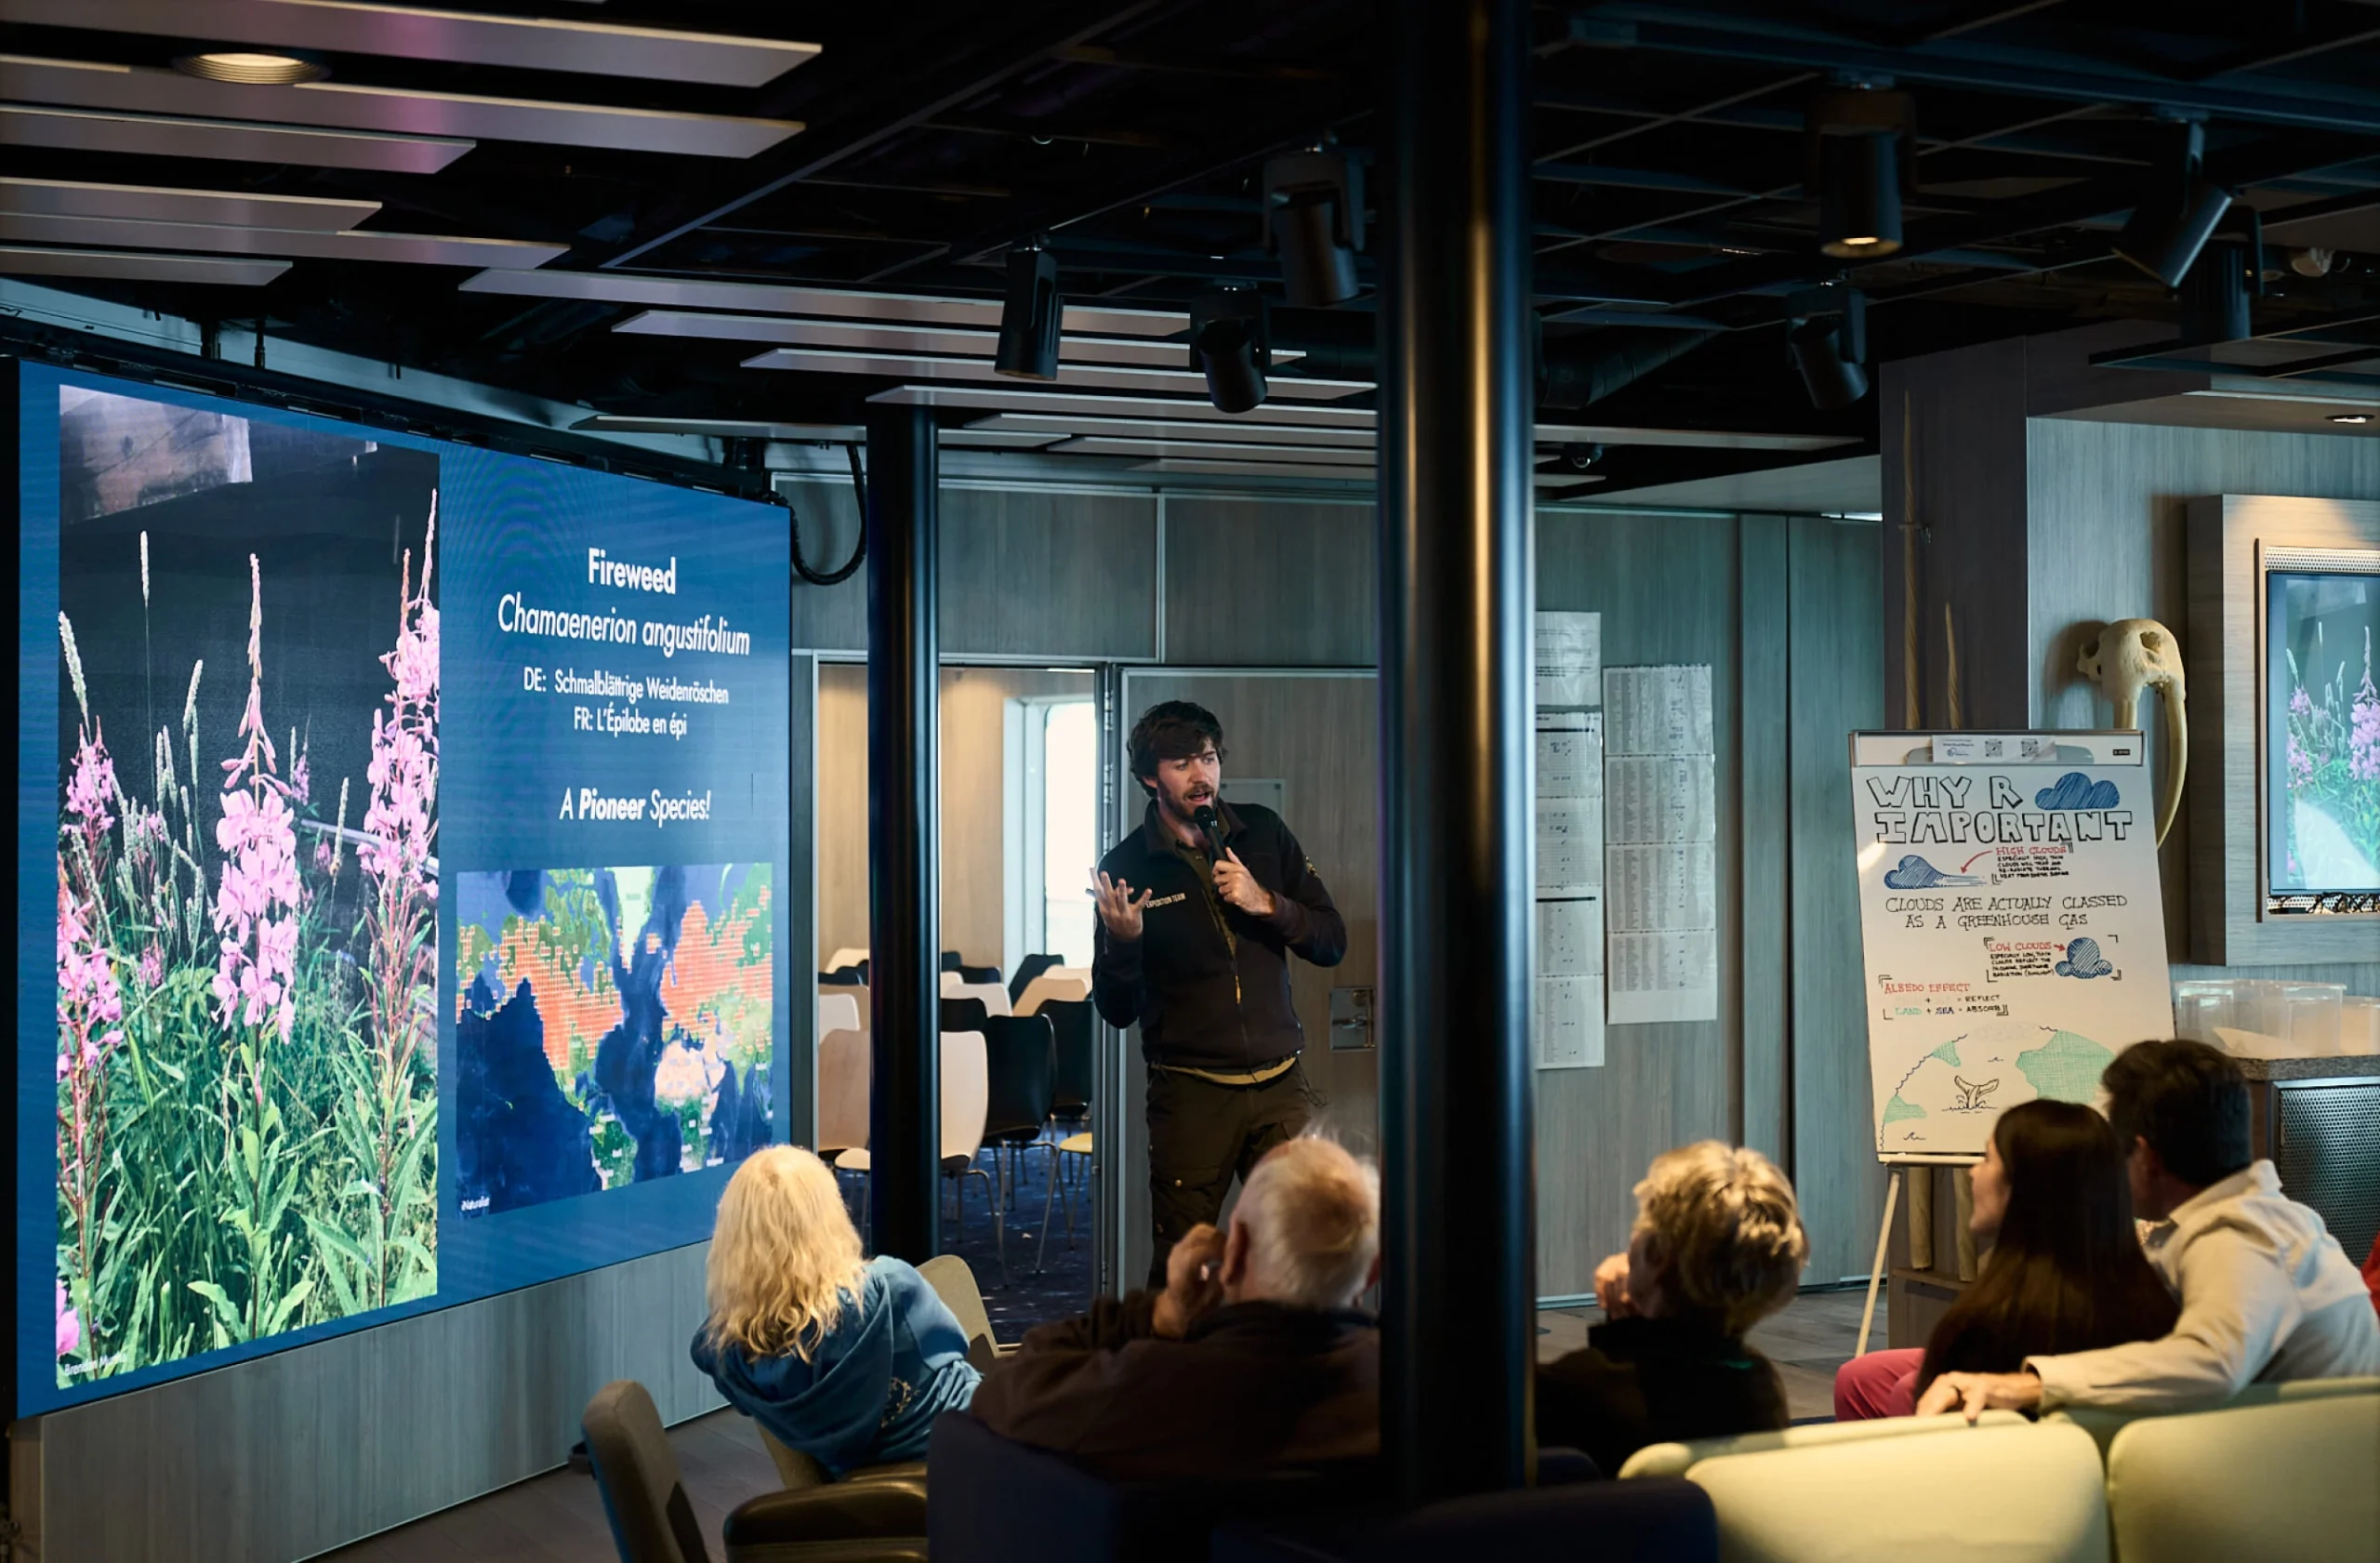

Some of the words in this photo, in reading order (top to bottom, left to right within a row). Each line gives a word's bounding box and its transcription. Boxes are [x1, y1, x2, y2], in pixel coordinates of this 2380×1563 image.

[588, 547, 676, 595] Fireweed
[497, 591, 637, 644] Chamaenerion
[641, 614, 750, 658] angustifolium
[523, 666, 547, 693] DE:
[554, 668, 643, 705] Schmalblättrige
[646, 676, 730, 705] Weidenröschen
[574, 706, 593, 731] FR:
[652, 716, 667, 735] en
[669, 712, 687, 741] épi
[1866, 775, 1973, 809] WHY
[1989, 775, 2024, 809] R
[559, 788, 574, 820] A
[578, 788, 646, 820] Pioneer
[649, 788, 712, 828] Species!
[1874, 810, 2133, 844] IMPORTANT
[1995, 846, 2025, 855] HIGH
[2029, 845, 2068, 854] CLOUDS
[1885, 897, 1944, 913] CLOUDS
[1950, 896, 1983, 912] ARE
[1988, 895, 2052, 911] ACTUALLY
[2062, 894, 2128, 909] CLASSED
[1905, 914, 1924, 928] AS
[1935, 915, 1947, 929] A
[1957, 913, 2049, 931] GREENHOUSE
[2058, 913, 2088, 930] GAS
[1989, 942, 2011, 952] LOW
[2015, 941, 2052, 951] CLOUDS
[1884, 983, 1924, 994] ALBEDO
[1928, 983, 1970, 993] EFFECT
[1964, 994, 2001, 1002] REFLECT
[1895, 1007, 1923, 1015] LAND
[1935, 1006, 1955, 1014] SEA
